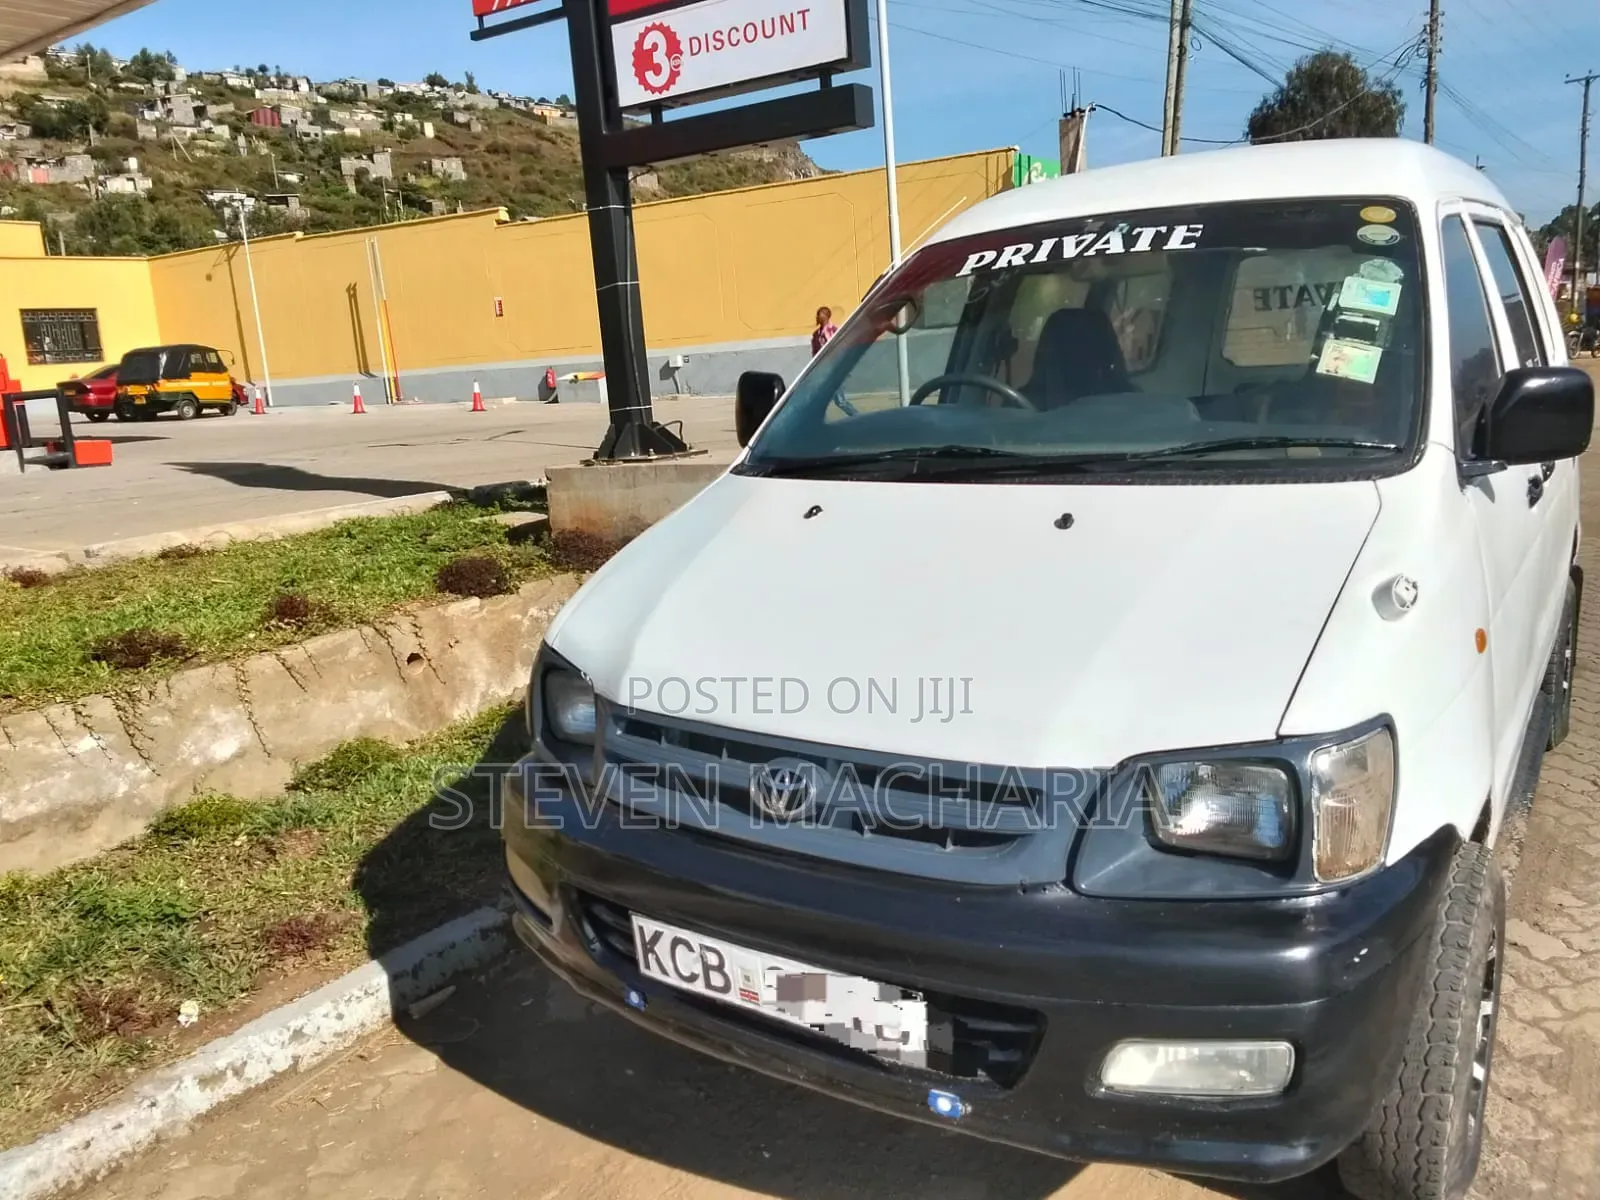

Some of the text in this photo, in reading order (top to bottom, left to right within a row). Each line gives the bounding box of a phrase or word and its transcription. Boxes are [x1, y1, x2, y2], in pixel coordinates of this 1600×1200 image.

[688, 8, 811, 57] DISCOUNT
[955, 223, 1204, 278] PRIVATE
[637, 924, 733, 995] KCB
